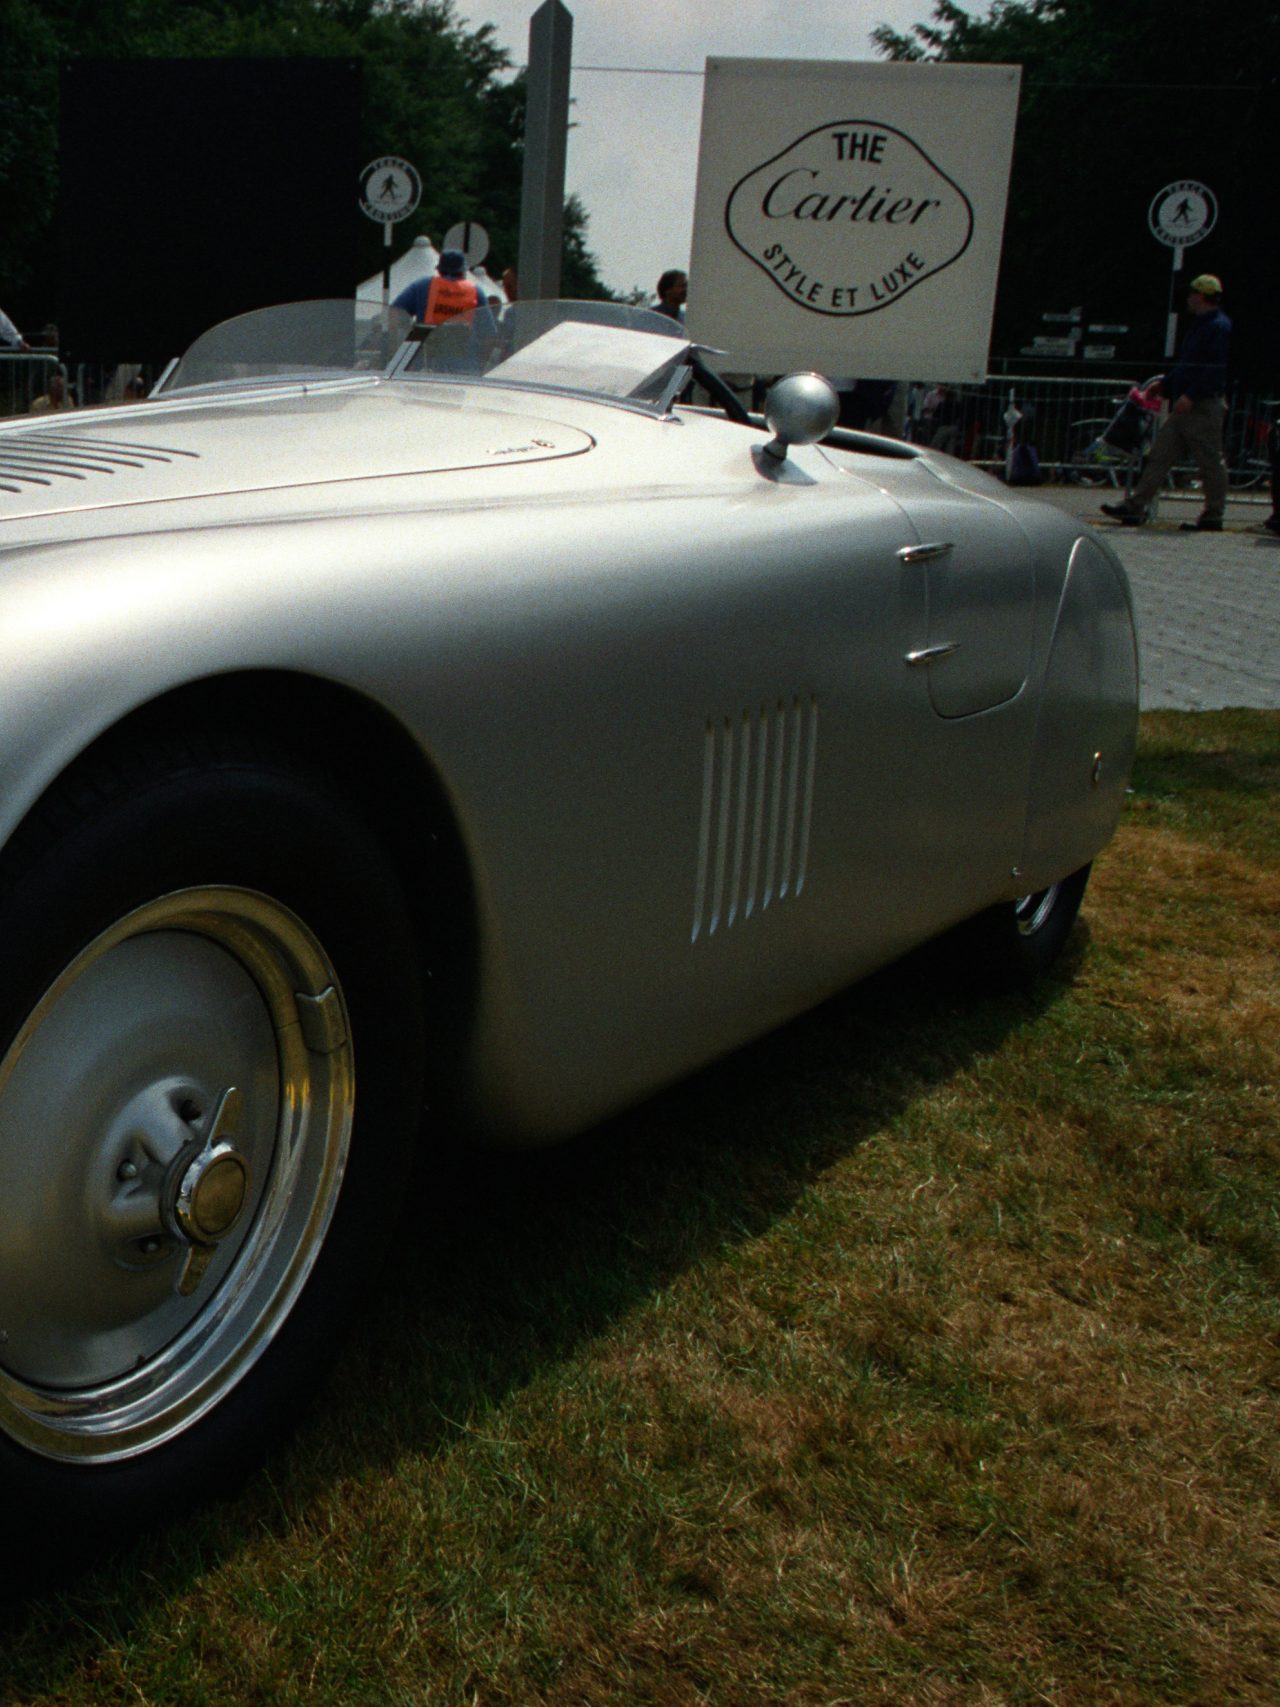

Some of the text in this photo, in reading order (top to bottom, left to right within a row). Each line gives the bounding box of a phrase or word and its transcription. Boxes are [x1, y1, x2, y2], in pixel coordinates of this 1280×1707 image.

[832, 132, 887, 163] THE
[761, 168, 941, 225] Cartier
[763, 243, 925, 307] STYLE ET LUXE
